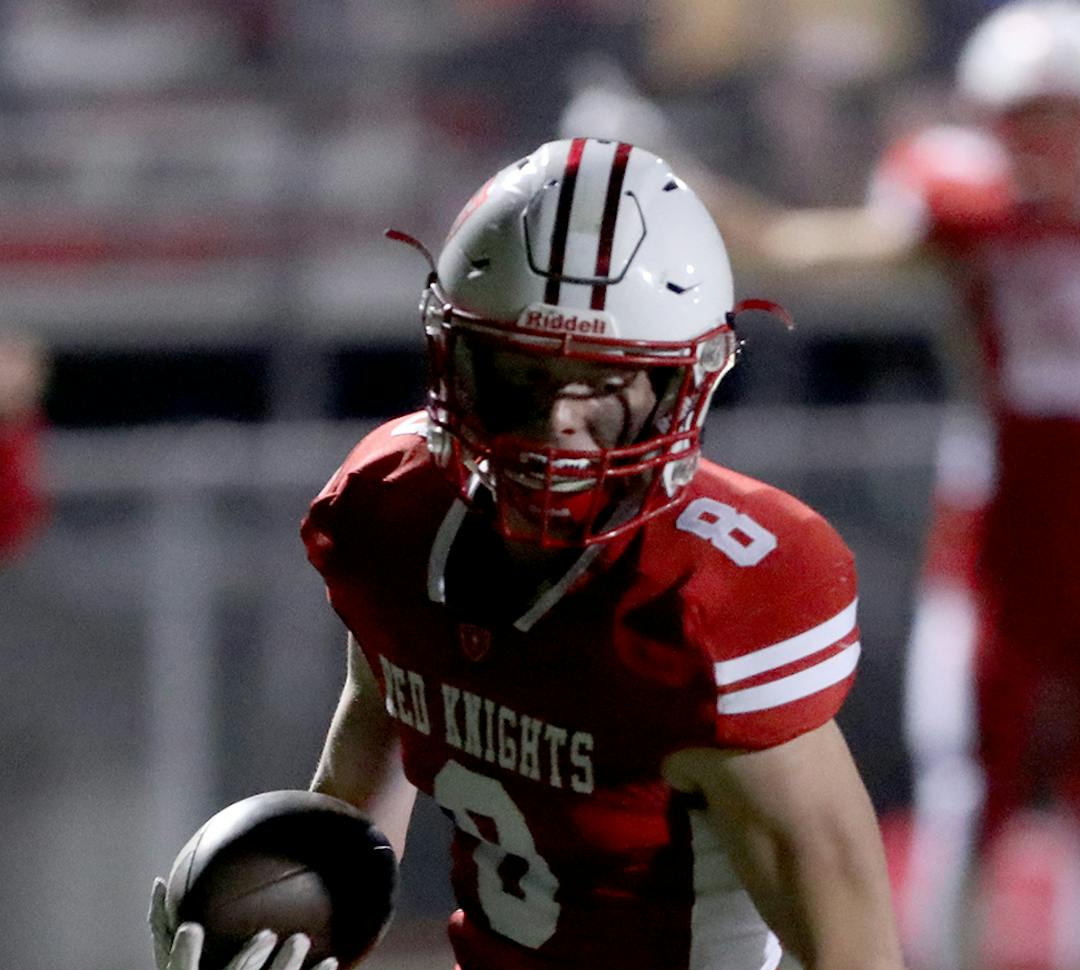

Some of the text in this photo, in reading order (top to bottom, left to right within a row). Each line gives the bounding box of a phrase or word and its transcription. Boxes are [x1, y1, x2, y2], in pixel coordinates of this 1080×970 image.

[525, 310, 607, 335] Riddell
[676, 497, 778, 568] 8
[441, 683, 594, 795] KNIGHTS
[434, 759, 561, 950] 8
